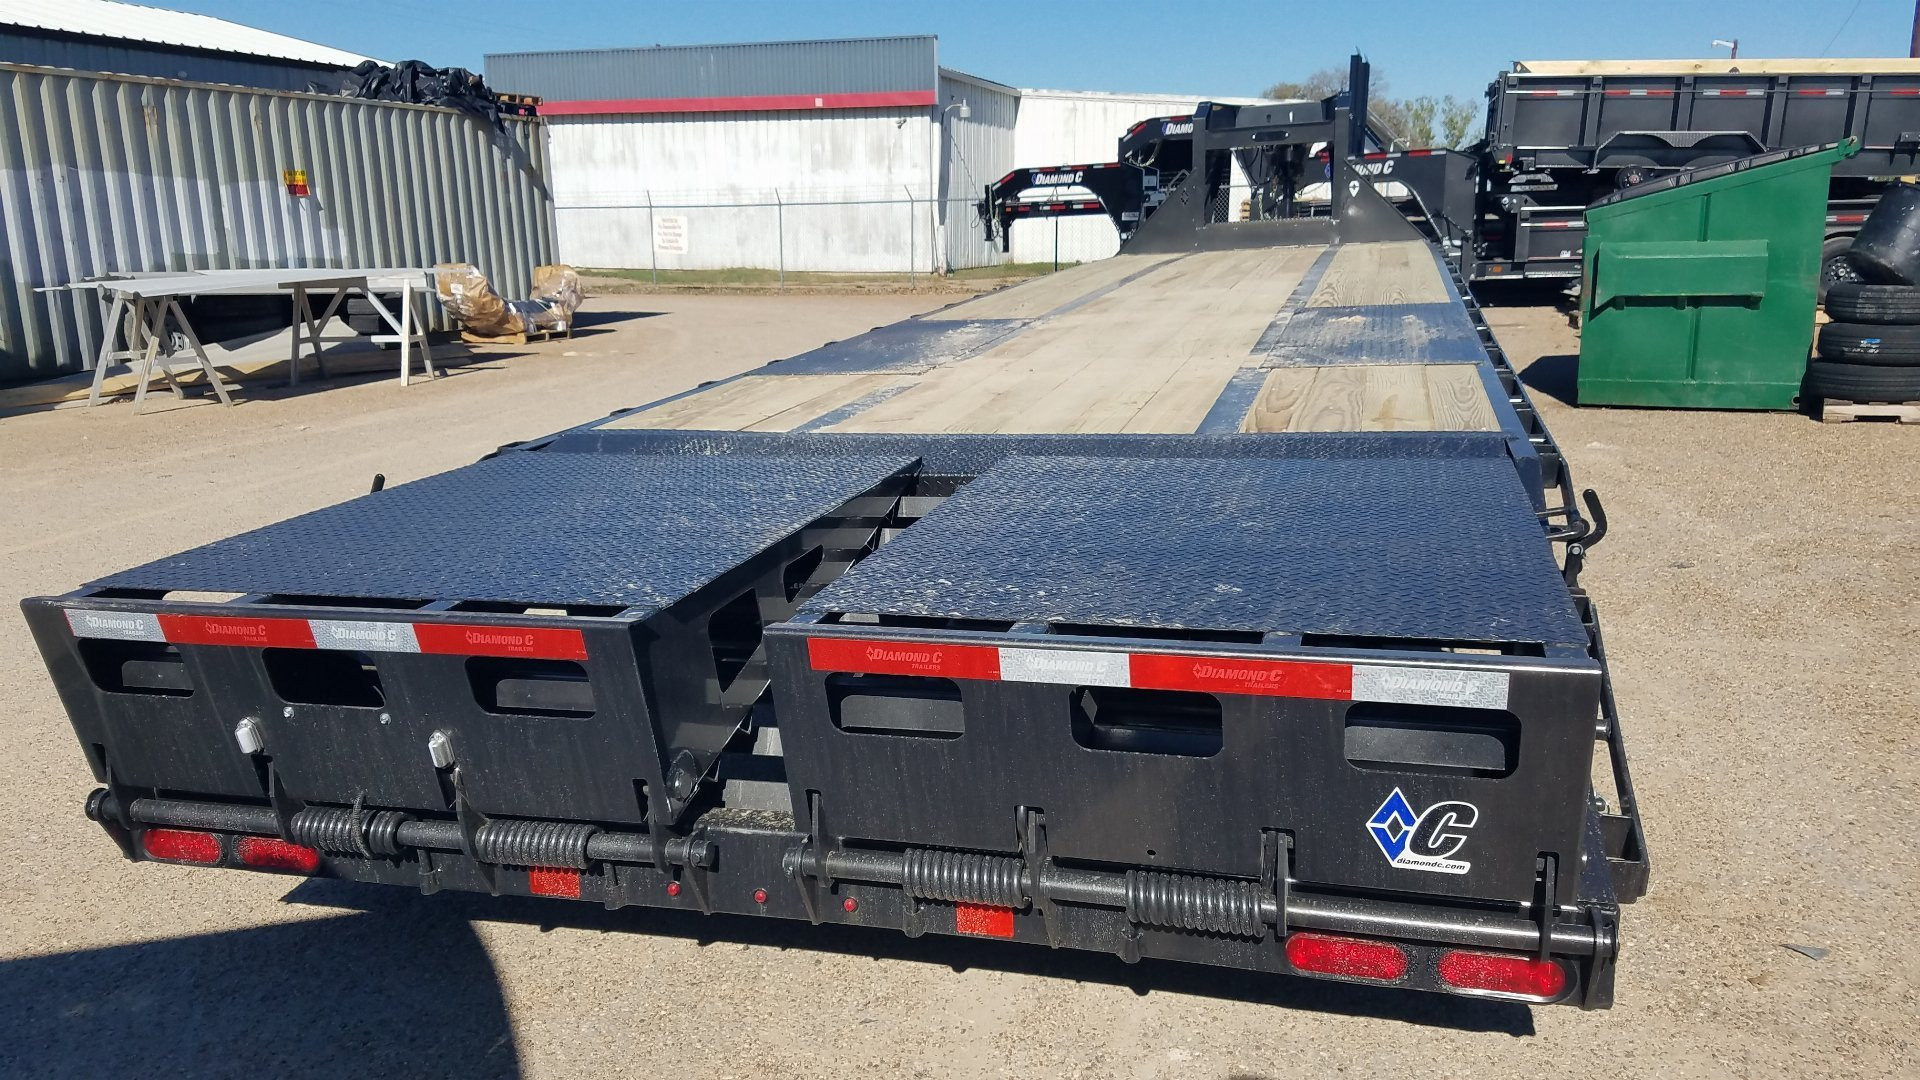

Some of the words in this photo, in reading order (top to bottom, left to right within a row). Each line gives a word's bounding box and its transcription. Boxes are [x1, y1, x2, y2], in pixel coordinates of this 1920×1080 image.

[1165, 123, 1194, 135] DIAMO
[1382, 160, 1395, 175] C
[1035, 173, 1075, 185] DIAMOND
[1075, 171, 1084, 183] C
[91, 614, 135, 630] DIAMOND
[135, 619, 144, 630] C
[210, 623, 256, 636] DIAMOND
[257, 624, 266, 636] C
[338, 627, 386, 641] DIAMOND
[387, 629, 396, 641] C
[472, 632, 523, 646] DIAMOND
[524, 634, 534, 646] C
[872, 648, 931, 663] DIAMOND
[932, 650, 943, 664] C
[911, 663, 941, 671] TRAILERS
[1199, 665, 1269, 682] DIAMOND
[1269, 669, 1282, 682] C
[1243, 681, 1279, 690] TRAILERS
[1391, 676, 1463, 692] DIAMOND
[1407, 801, 1479, 858] C
[1396, 858, 1466, 870] diamondc.com
